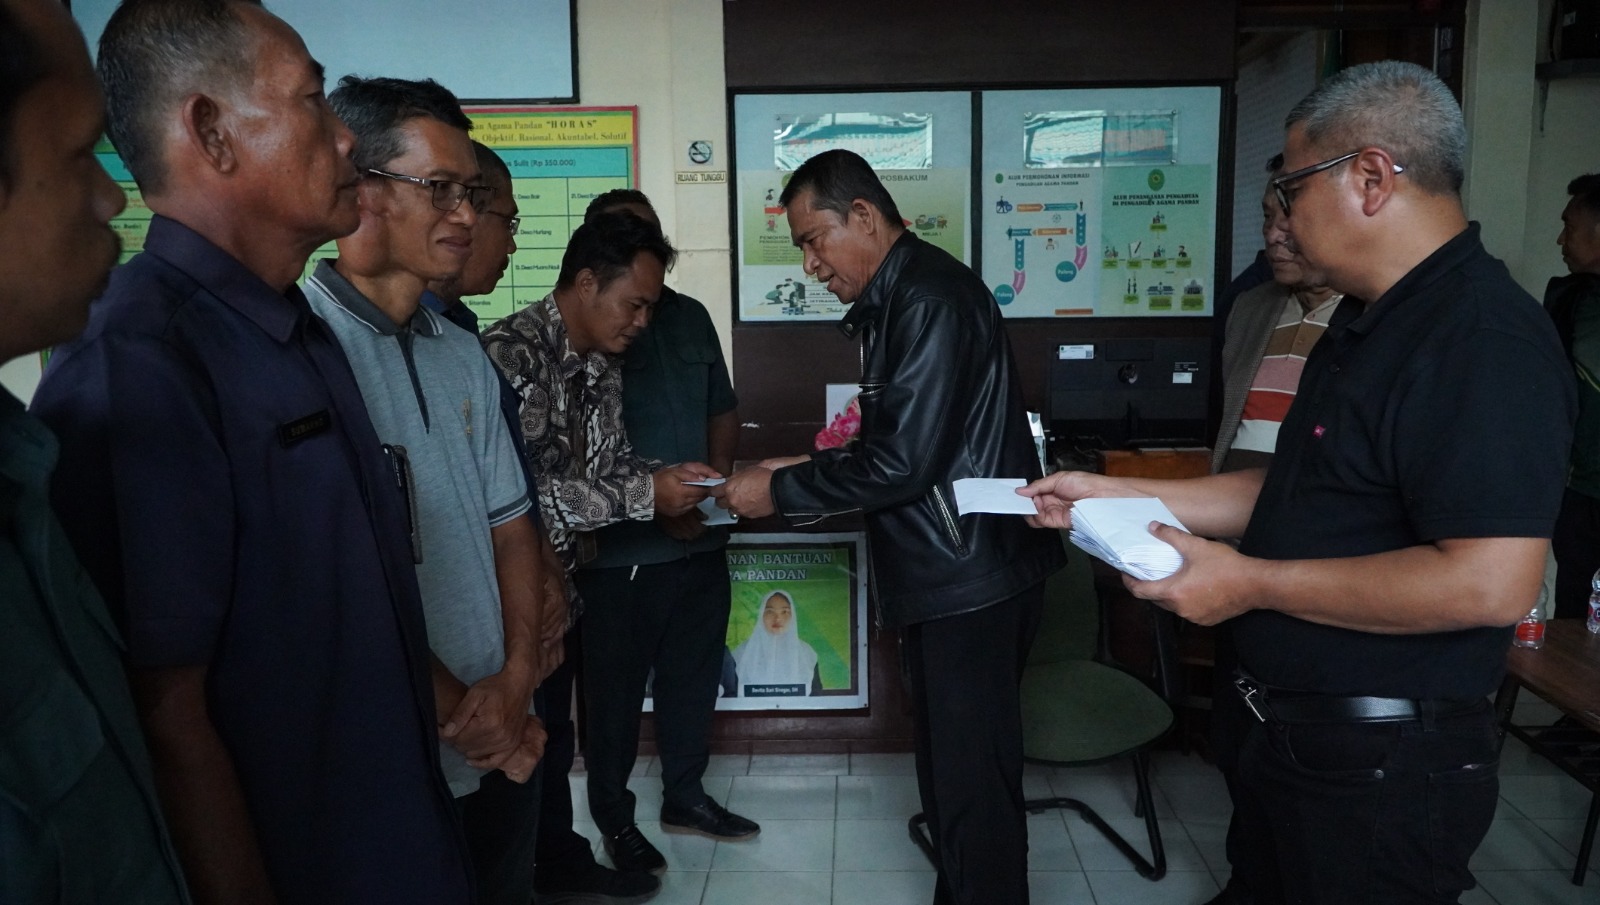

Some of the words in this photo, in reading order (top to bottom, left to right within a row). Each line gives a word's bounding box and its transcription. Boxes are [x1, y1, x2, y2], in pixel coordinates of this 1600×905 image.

[488, 122, 512, 131] Agama
[515, 121, 543, 130] Pandan
[601, 131, 627, 140] Solutif
[677, 174, 698, 182] RUANG
[701, 173, 725, 182] TUNGGU
[880, 174, 928, 182] POSBAKUM
[763, 553, 832, 565] BANTUAN
[747, 569, 806, 580] PANDAN
